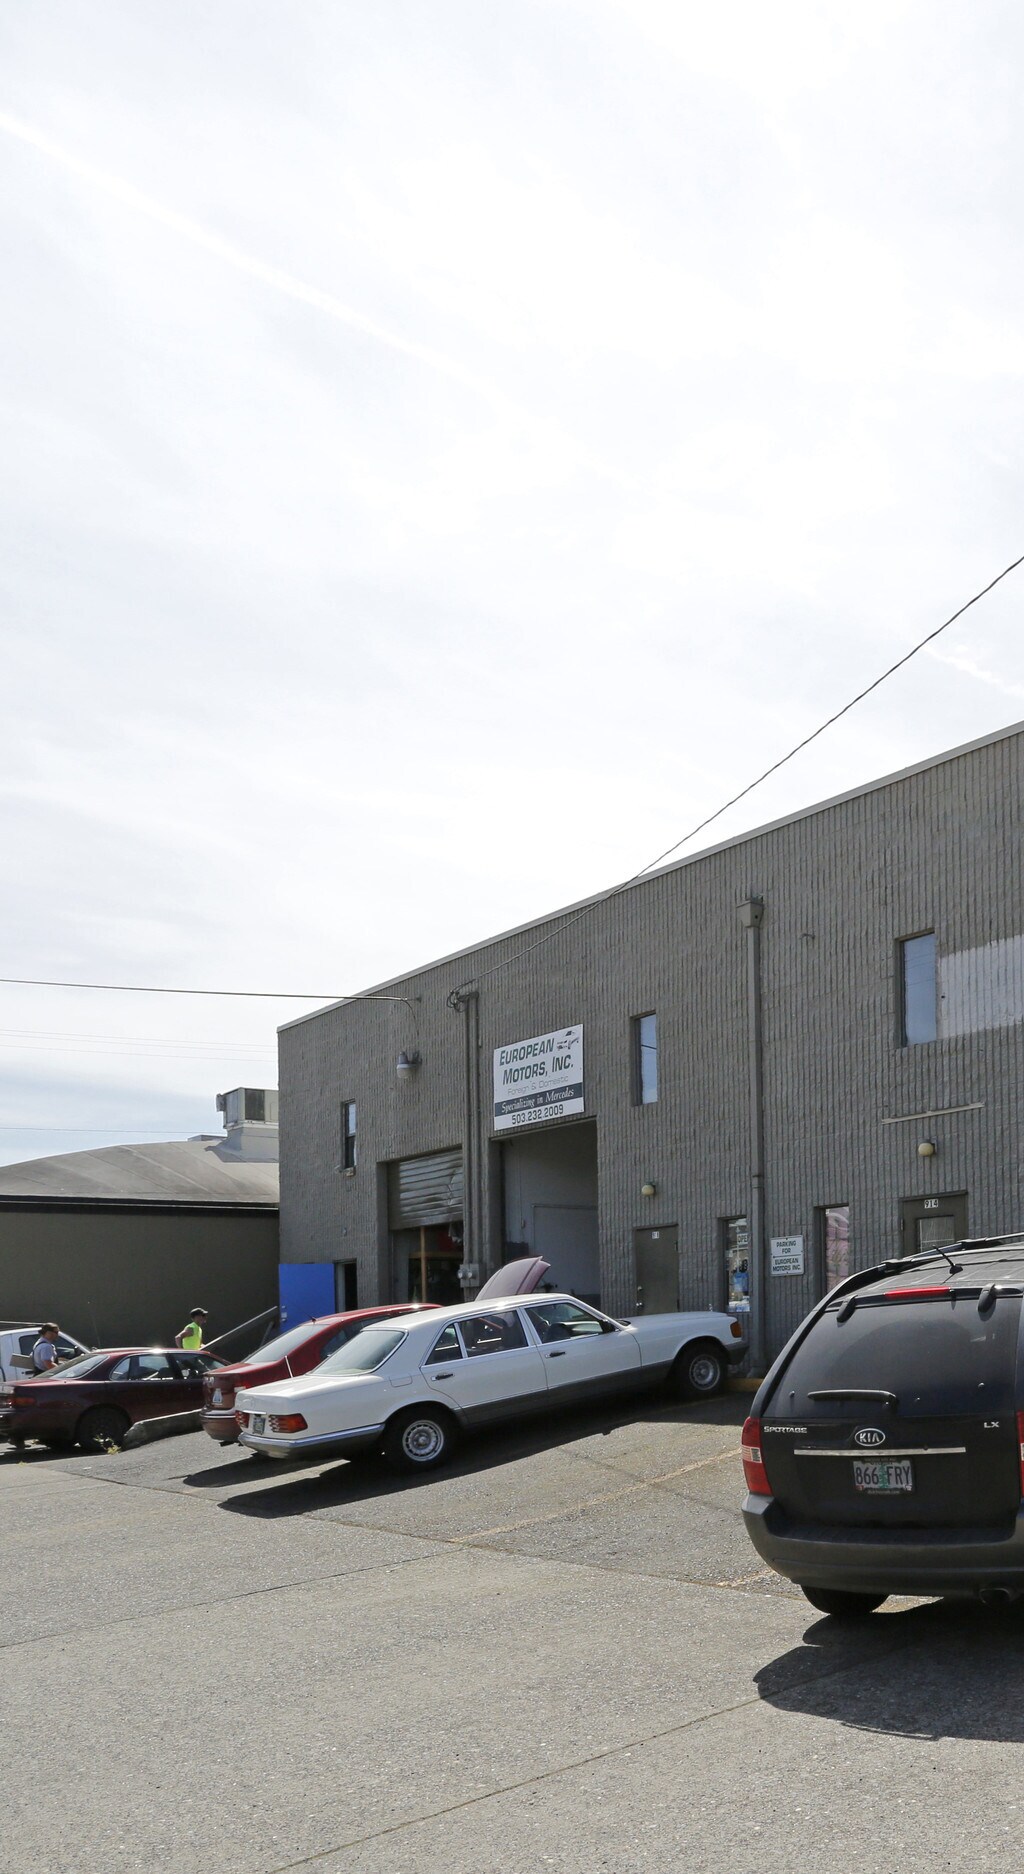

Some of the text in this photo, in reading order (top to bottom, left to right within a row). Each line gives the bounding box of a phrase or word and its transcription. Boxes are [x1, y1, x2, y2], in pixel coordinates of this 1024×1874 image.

[499, 1038, 555, 1066] EUROPEAN
[502, 1054, 574, 1086] MOTORS, INC.
[507, 1076, 569, 1096] Foreign & Domestic
[501, 1087, 575, 1114] Specializing in Mercedes
[511, 1104, 564, 1125] 503.232.2009
[924, 1199, 938, 1208] 914
[738, 1235, 748, 1243] OPE
[772, 1264, 791, 1272] MOTORS
[763, 1425, 808, 1434] SPORTAGE
[983, 1421, 1000, 1429] LX
[859, 1432, 880, 1443] KIA
[855, 1466, 912, 1486] 866 FRY
